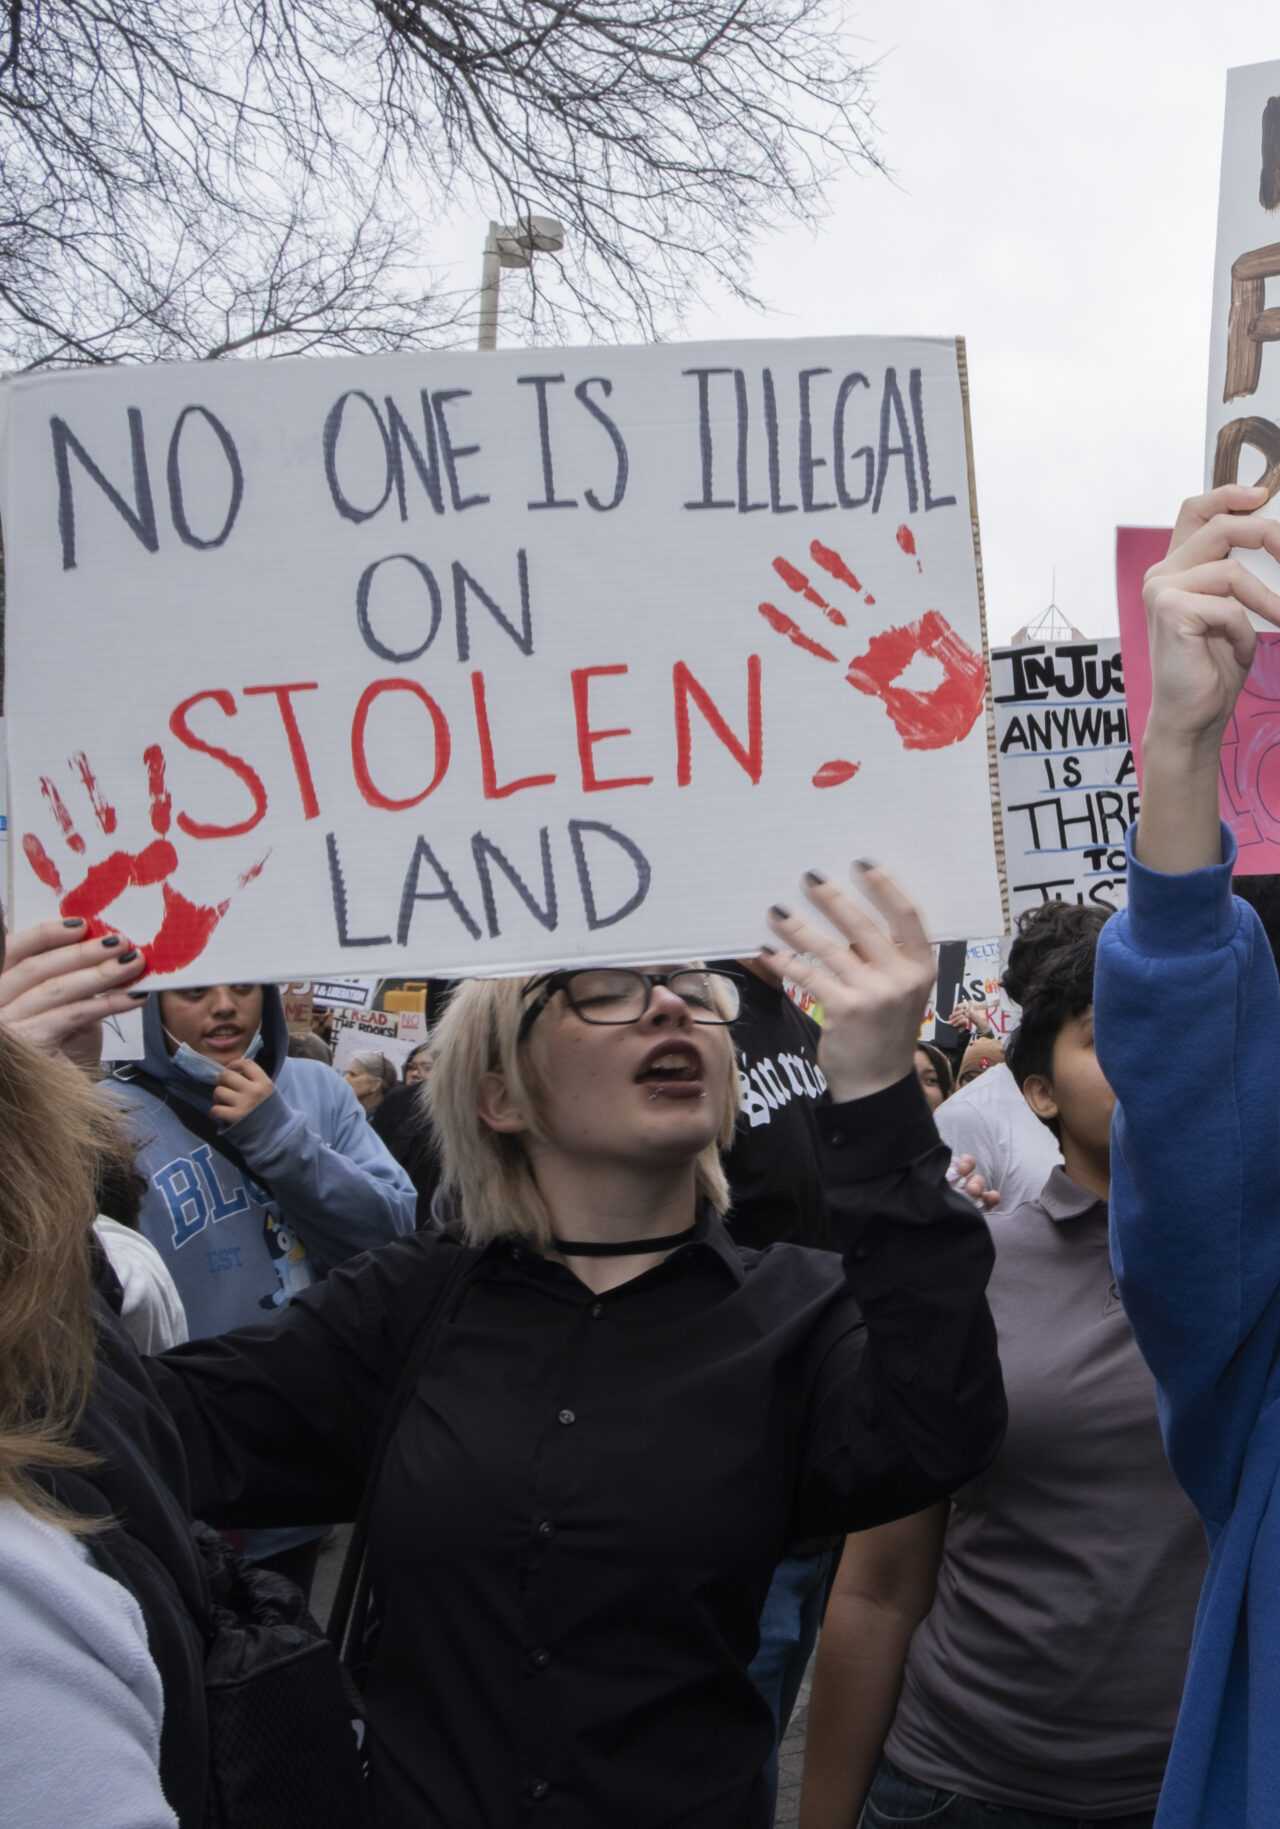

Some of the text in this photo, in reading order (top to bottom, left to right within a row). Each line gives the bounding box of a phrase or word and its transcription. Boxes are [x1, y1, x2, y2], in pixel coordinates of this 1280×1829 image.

[50, 367, 957, 570] NO ONE IS ILLEGAL
[356, 549, 534, 663] ON
[168, 654, 764, 839] STOLEN
[1043, 750, 1137, 789] IS A
[326, 818, 652, 947] LAND
[1083, 847, 1128, 872] TO
[351, 1009, 387, 1025] READ
[207, 1247, 242, 1273] EST
